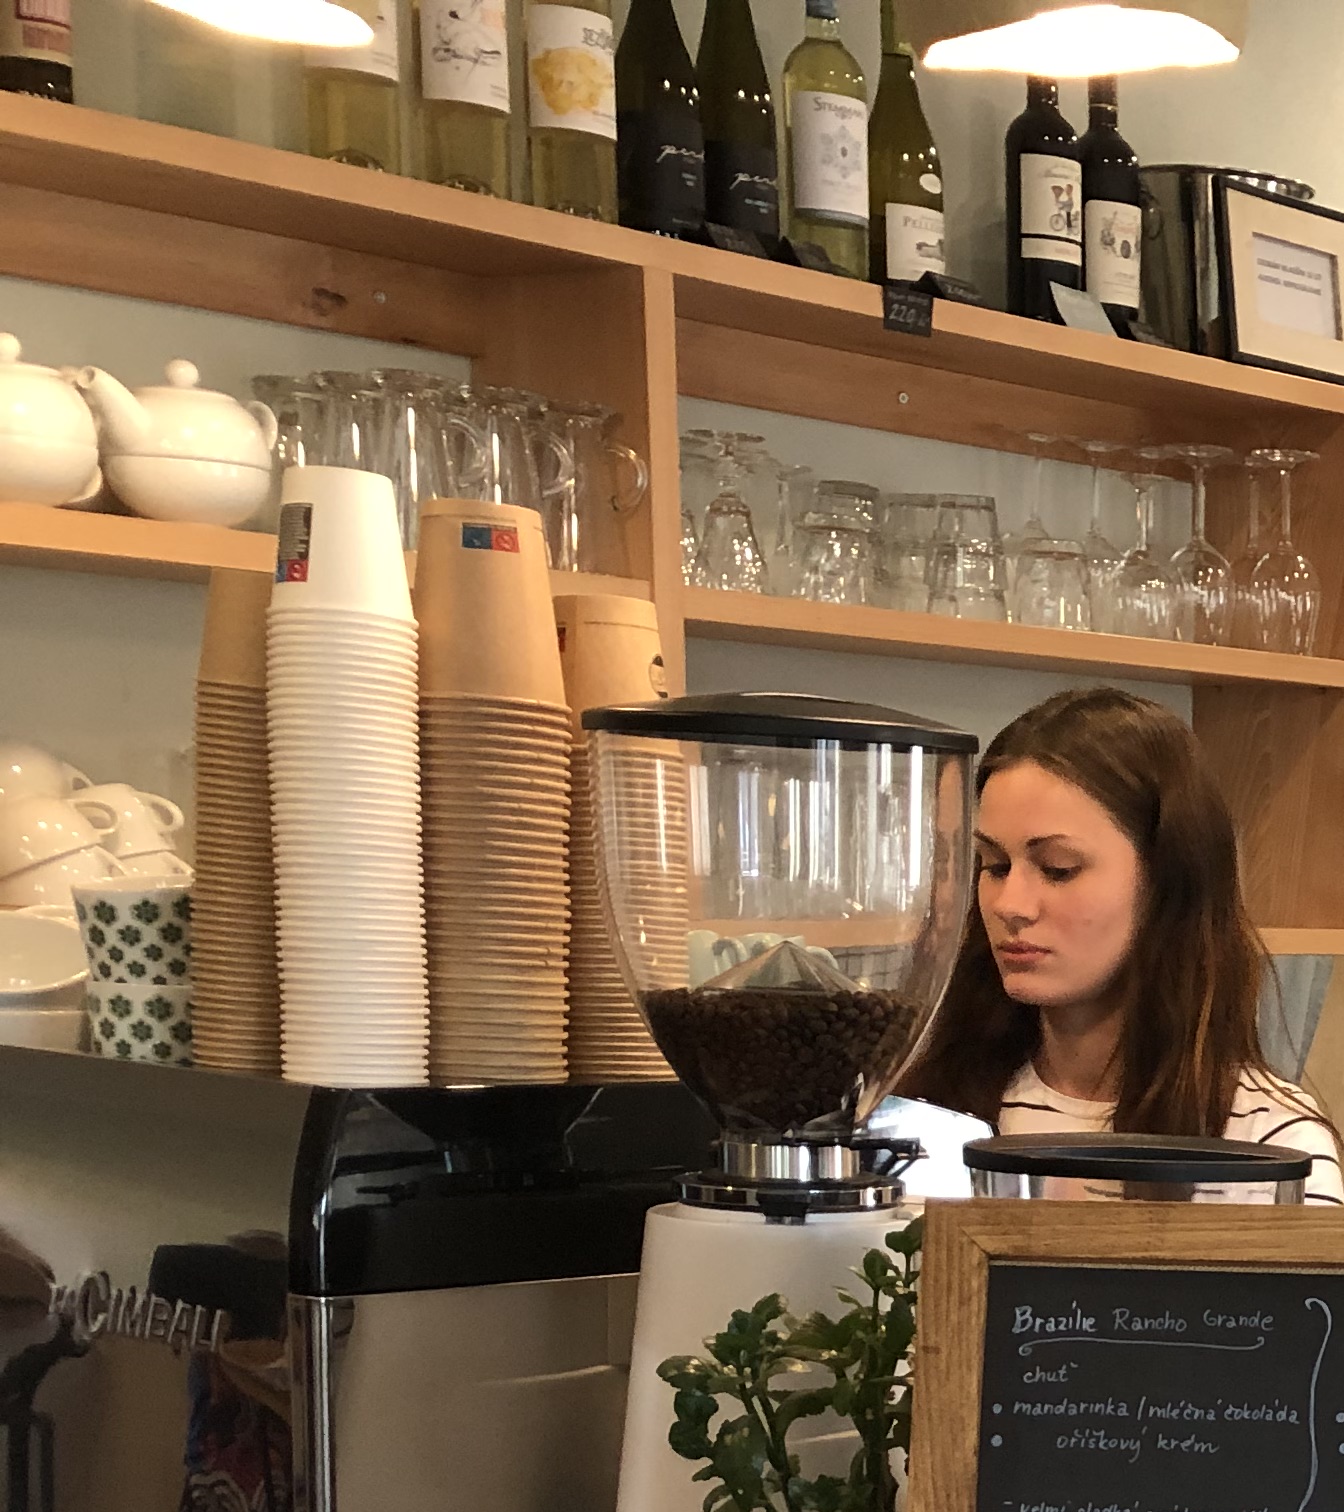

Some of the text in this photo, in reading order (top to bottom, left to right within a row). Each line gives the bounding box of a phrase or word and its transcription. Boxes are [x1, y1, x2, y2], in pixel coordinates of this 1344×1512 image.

[1011, 1300, 1274, 1333] Brazílie Rancho Grande
[1023, 1362, 1079, 1383] chuť
[1013, 1397, 1129, 1416] mandarinka
[1223, 1399, 1300, 1424] čokoláda
[1057, 1426, 1220, 1463] oříškový krém
